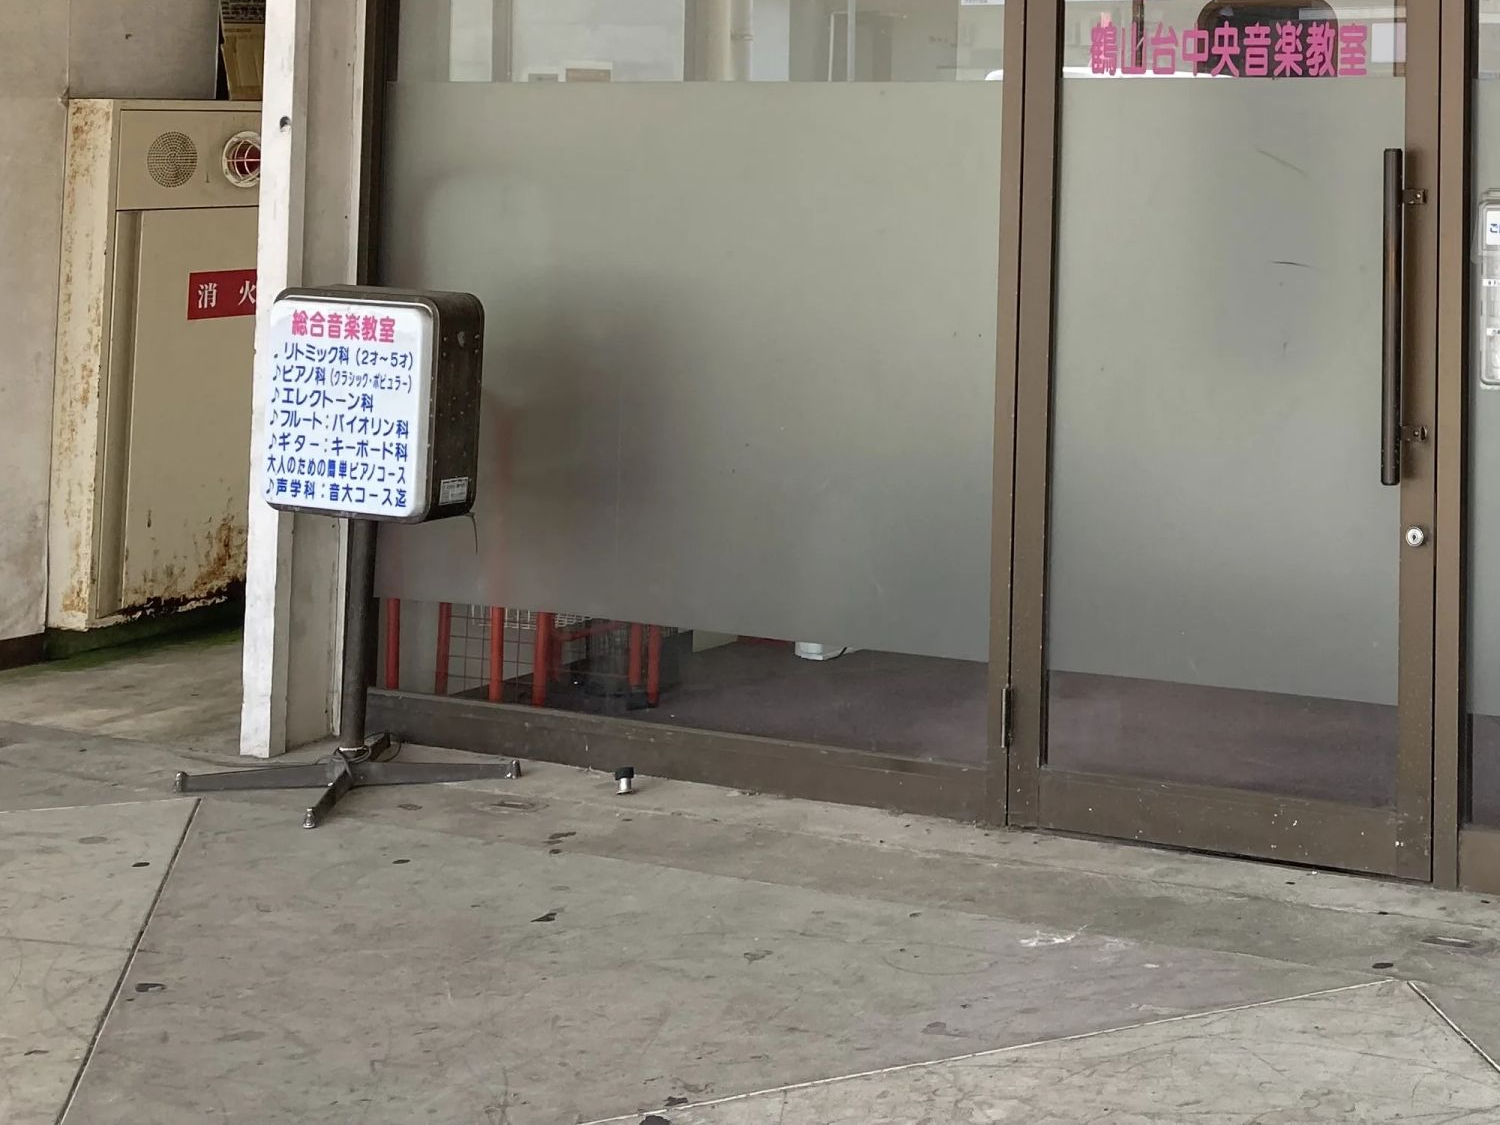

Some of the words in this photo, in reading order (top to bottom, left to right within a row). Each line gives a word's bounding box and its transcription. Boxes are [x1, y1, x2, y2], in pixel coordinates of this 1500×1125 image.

[1090, 20, 1368, 77] 鶴山台中央音楽教室
[292, 310, 396, 343] 総合音楽教室
[282, 388, 374, 412] エレクトーン科
[267, 454, 406, 484] 大人のための簡単ピアノコース
